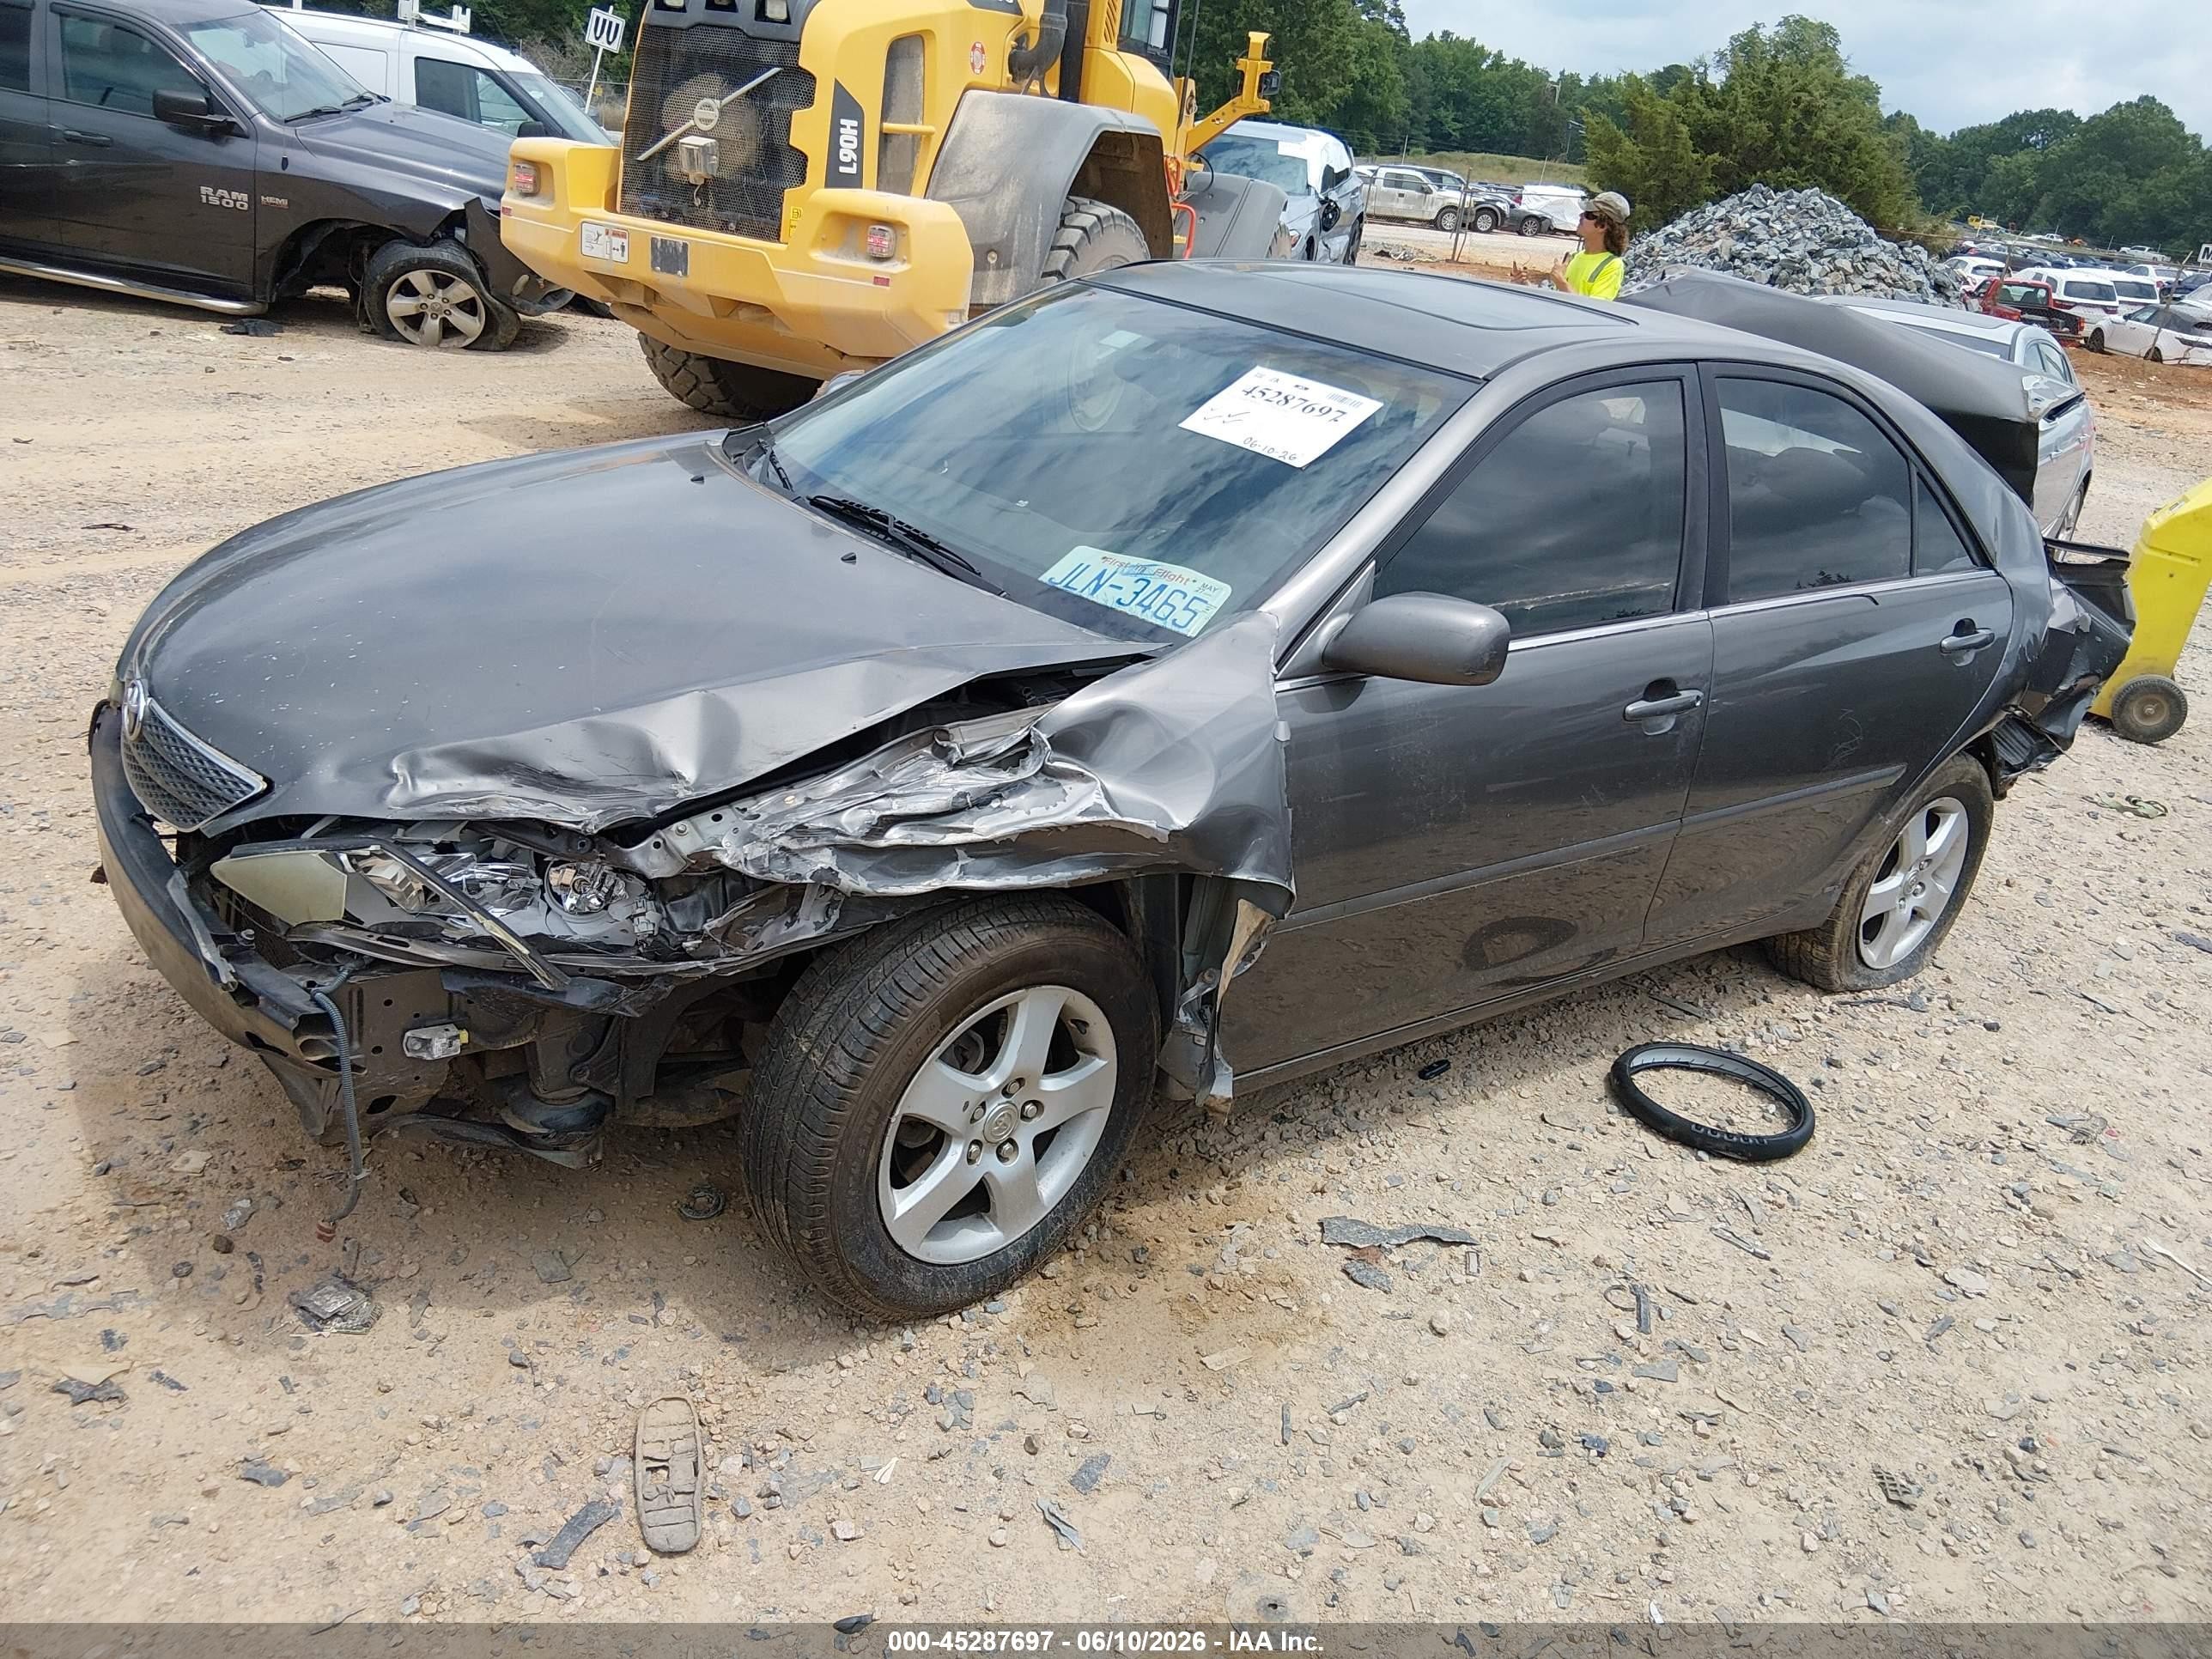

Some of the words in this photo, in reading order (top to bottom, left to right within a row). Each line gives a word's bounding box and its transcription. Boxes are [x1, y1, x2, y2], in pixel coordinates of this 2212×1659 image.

[839, 118, 859, 174] L90H
[199, 185, 248, 203] RAM
[200, 194, 249, 211] 1500
[1242, 386, 1347, 422] 45287697
[1243, 437, 1297, 461] 06-10-26
[1102, 556, 1130, 569] First
[1134, 562, 1147, 574] in
[1153, 568, 1191, 586] Flight
[1048, 562, 1209, 629] JLN-3465
